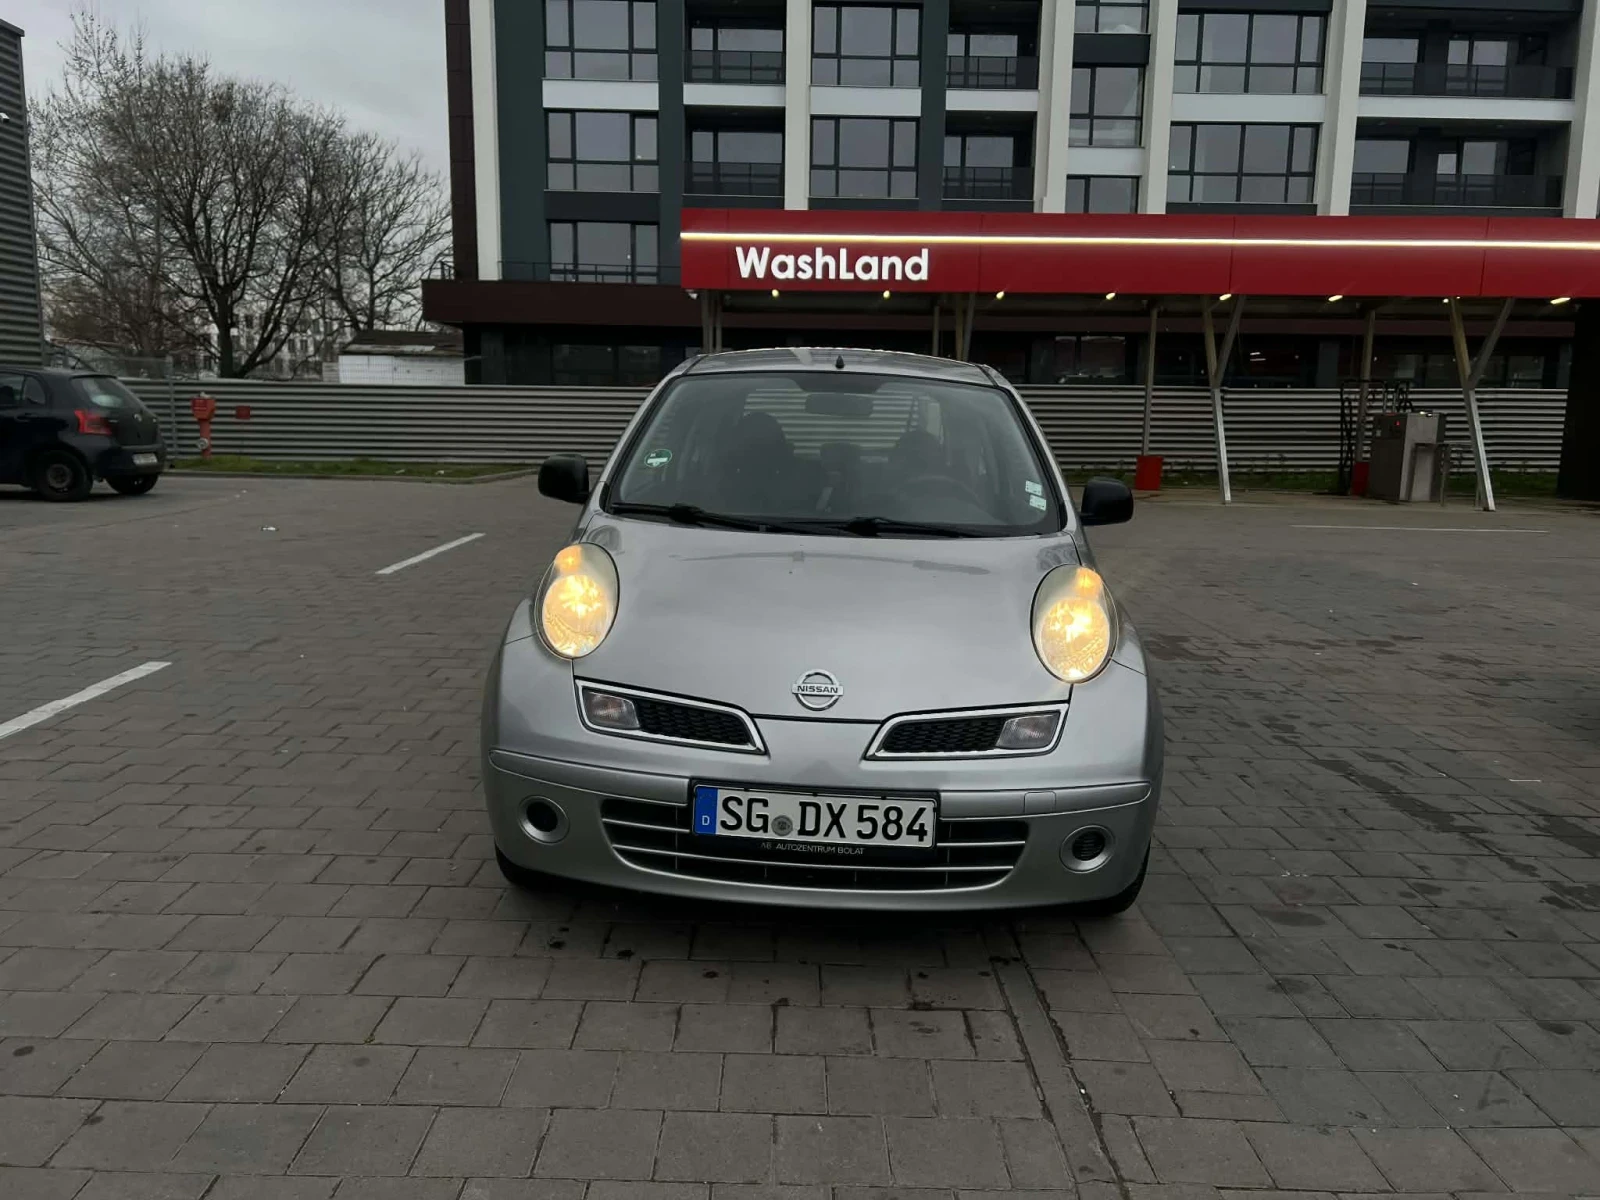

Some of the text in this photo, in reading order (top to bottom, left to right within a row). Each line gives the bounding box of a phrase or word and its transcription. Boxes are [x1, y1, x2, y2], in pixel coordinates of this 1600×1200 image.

[736, 246, 929, 280] WashLand
[797, 685, 838, 693] NISSAN
[702, 815, 710, 825] D
[720, 796, 928, 842] SG DX 584
[776, 843, 835, 853] AUTOZENTRUM
[837, 847, 864, 855] BOLAT
